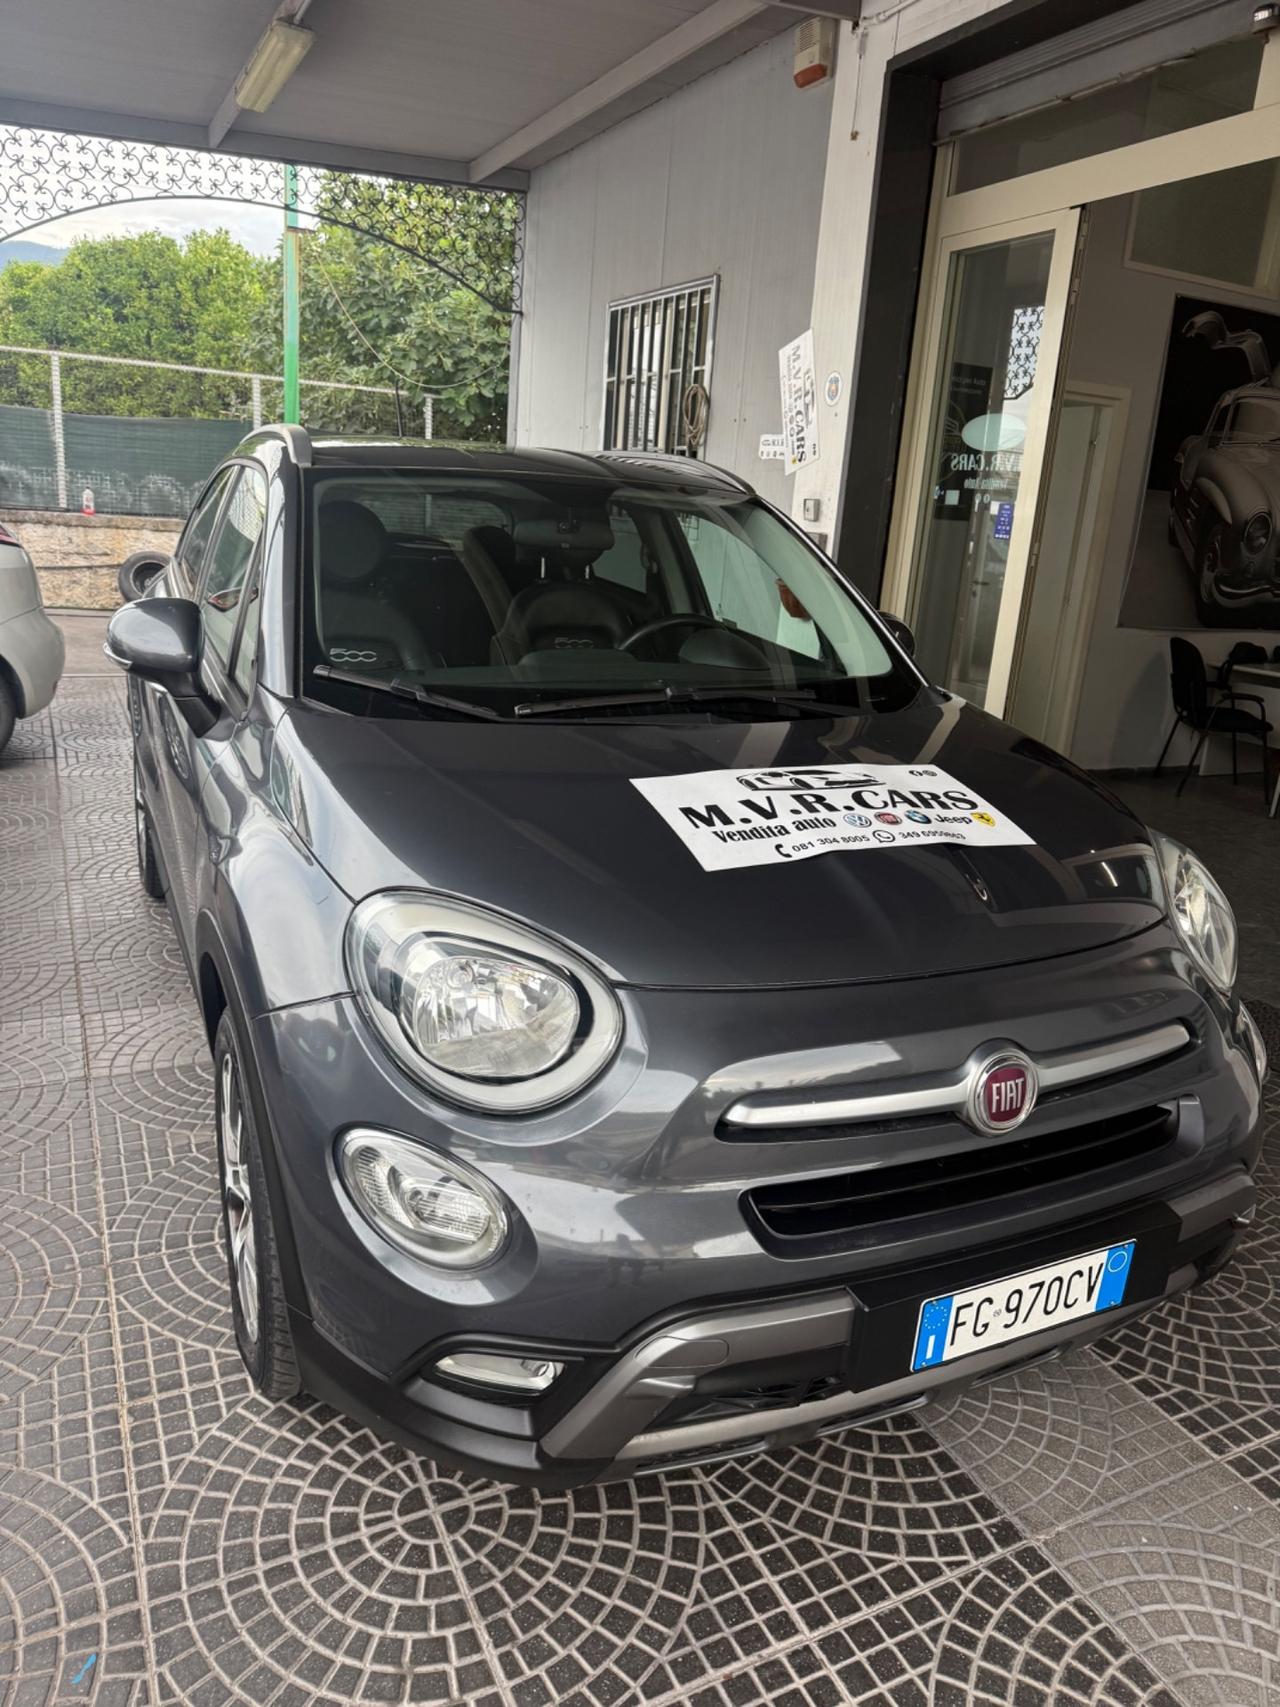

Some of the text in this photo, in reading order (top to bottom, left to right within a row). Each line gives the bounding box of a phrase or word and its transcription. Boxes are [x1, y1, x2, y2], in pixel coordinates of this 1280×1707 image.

[330, 648, 377, 662] 500
[792, 816, 838, 831] auto
[935, 813, 972, 824] Jeep
[791, 834, 870, 852] 081 304 8005
[992, 1078, 1024, 1113] FIAT
